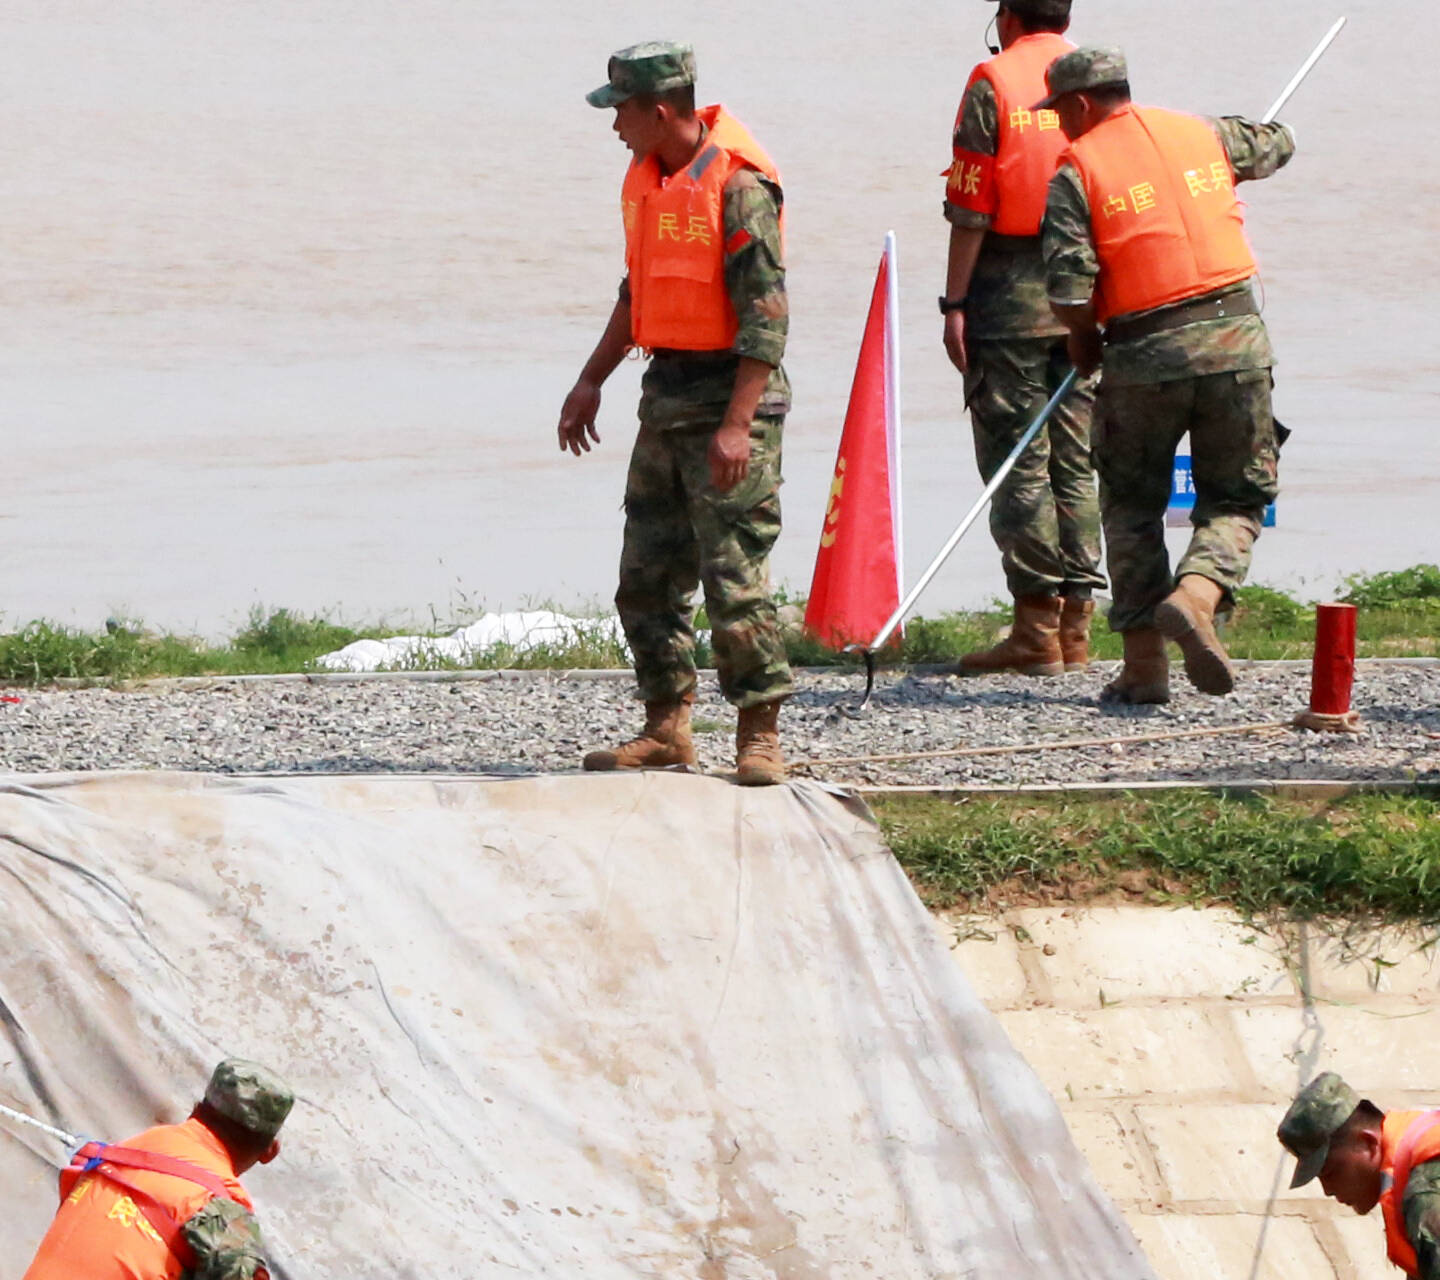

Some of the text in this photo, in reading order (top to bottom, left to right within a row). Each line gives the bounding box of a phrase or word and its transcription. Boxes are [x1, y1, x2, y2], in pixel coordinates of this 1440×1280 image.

[1009, 105, 1060, 134] 中国
[1103, 161, 1230, 218] 中国 民兵
[658, 213, 711, 246] 民兵
